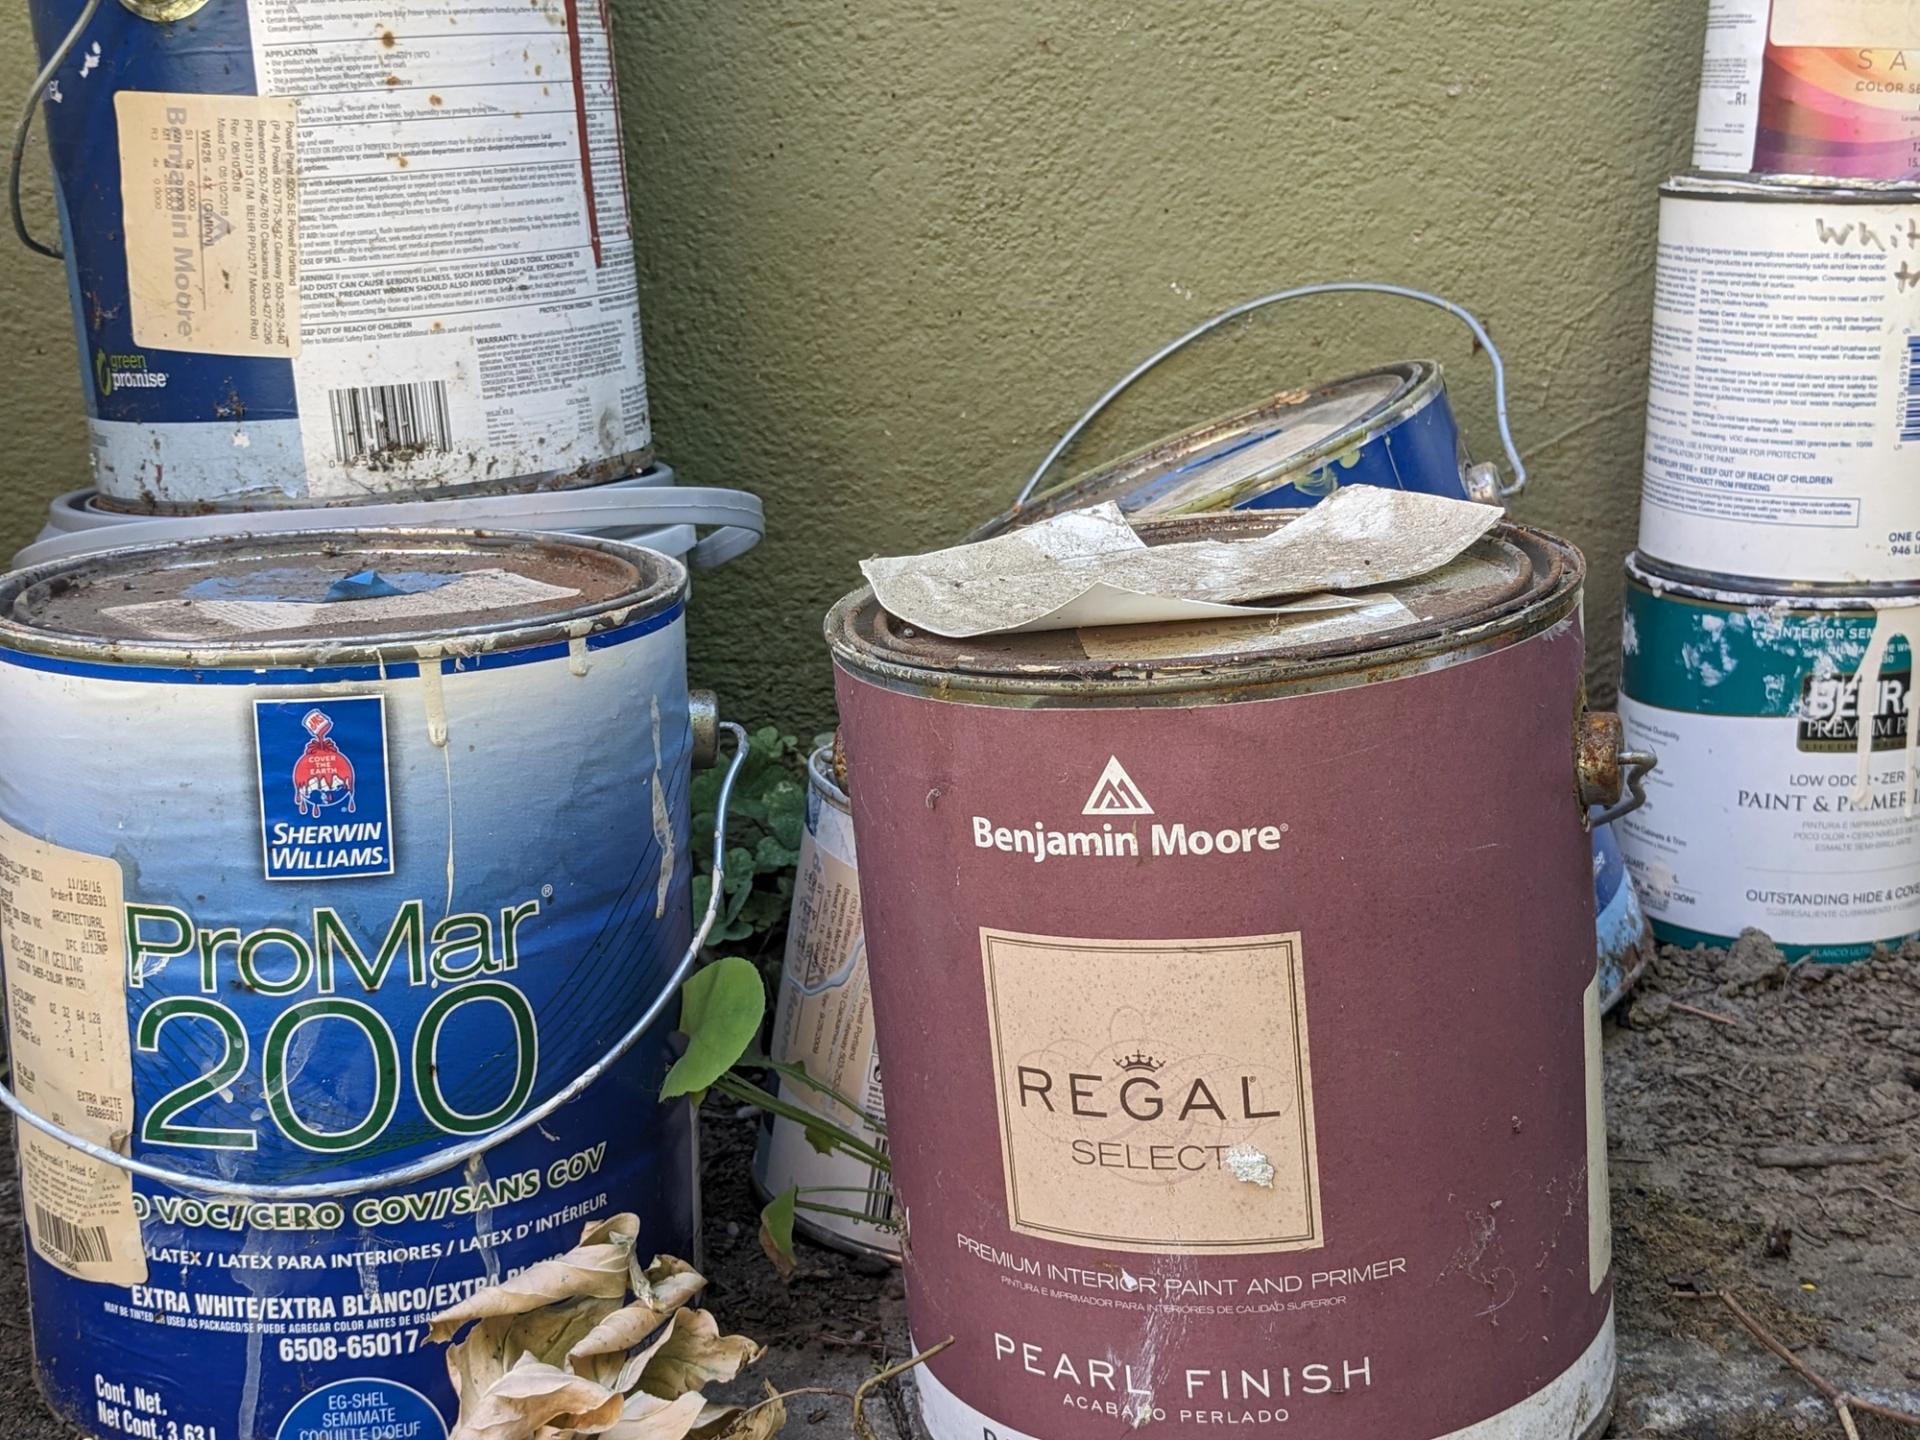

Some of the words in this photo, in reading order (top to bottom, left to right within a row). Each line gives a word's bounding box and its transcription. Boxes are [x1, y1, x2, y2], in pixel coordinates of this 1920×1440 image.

[265, 48, 318, 58] APPLICATION
[1856, 80, 1904, 93] COLOR
[258, 120, 267, 164] Beaverton
[270, 120, 281, 143] (P-4)
[286, 121, 296, 150] Powell
[272, 146, 282, 175] Powell
[286, 152, 296, 176] Paint
[246, 205, 256, 232] BEHR
[288, 203, 296, 216] SE
[288, 220, 297, 247] Powell
[260, 231, 270, 280] Clackamas
[273, 241, 284, 280] Gateway
[288, 250, 298, 286] Portland
[502, 256, 520, 266] LEAD
[173, 246, 195, 338] Moore
[316, 282, 338, 290] DUST
[339, 281, 356, 290] CAN
[358, 279, 384, 288] CAUSE
[454, 272, 474, 281] SUCH
[475, 270, 484, 279] AS
[486, 268, 506, 278] BRAIN
[338, 288, 382, 298] PREGNANT
[383, 286, 415, 296] WOMEN
[416, 283, 448, 293] SHOULD
[449, 281, 469, 290] ALSO
[470, 276, 492, 287] AVOID
[249, 278, 258, 316] Morocco
[276, 282, 286, 344] 503-252-2440
[368, 324, 377, 332] OF
[378, 322, 412, 331] CHILDREN
[110, 354, 146, 372] green
[112, 368, 167, 391] promise
[1718, 468, 1734, 478] OUT
[1747, 472, 1775, 482] REACH
[1777, 474, 1788, 483] OF
[1790, 474, 1833, 485] CHILDREN
[1888, 532, 1912, 542] ONE
[308, 755, 336, 763] COVER
[310, 766, 337, 775] EARTH
[1789, 774, 1824, 787] LOW
[1738, 789, 1807, 812] PAINT
[1812, 796, 1830, 813] &
[272, 822, 382, 846] SHERWIN
[972, 815, 1139, 863] Benjamin
[1151, 822, 1282, 856] Moore
[272, 846, 384, 870] WILLIAMS
[1745, 889, 1849, 906] OUTSTANDING
[1852, 890, 1884, 904] HIDE
[124, 898, 540, 994] ProMar
[136, 981, 540, 1152] 200
[1018, 1066, 1282, 1122] REGAL
[1072, 1138, 1231, 1171] SELECT
[152, 1195, 346, 1232] VOC/CERO
[353, 1168, 542, 1227] COV/SANS
[547, 1141, 608, 1188] COV
[151, 1246, 202, 1266] LATEX
[218, 1253, 273, 1270] LATEX
[278, 1253, 326, 1270] PARA
[331, 1243, 442, 1268] INTERIORES
[459, 1225, 513, 1252] LATEX
[956, 1232, 1041, 1277] PREMIUM
[1047, 1264, 1158, 1294] INTERIOR
[1166, 1278, 1238, 1296] PAINT
[1246, 1275, 1303, 1296] AND
[1311, 1257, 1407, 1290] PRIMER
[131, 1284, 190, 1314] EXTRA
[195, 1293, 337, 1321] WHITE/EXTRA
[1001, 1274, 1040, 1294] PINTURA
[1041, 1287, 1048, 1296] E
[1050, 1288, 1113, 1308] IMPRIMADOR
[1114, 1300, 1145, 1312] PARA
[1146, 1302, 1215, 1315] INTERIORES
[1217, 1304, 1234, 1315] DE
[1236, 1302, 1284, 1314] CALIDAD
[1286, 1295, 1347, 1312] SUPERIOR
[104, 1301, 119, 1314] MAY
[120, 1305, 129, 1317] BE
[130, 1307, 154, 1322] TINTED
[166, 1314, 186, 1328] USED
[187, 1317, 198, 1329] AS
[199, 1319, 255, 1334] PACKAGED/SE
[256, 1322, 286, 1334] PUEDE
[288, 1321, 331, 1335] AGREGAR
[334, 1319, 364, 1332] COLOR
[366, 1317, 396, 1330] ANTES
[399, 1314, 411, 1326] DE
[279, 1328, 419, 1362] 6508-65017
[994, 1332, 1152, 1396] PEARL
[1185, 1357, 1372, 1400] FINISH
[95, 1373, 132, 1408] Cont.
[134, 1386, 168, 1416] Net.
[328, 1392, 388, 1411] EG-SHEL
[97, 1401, 121, 1430] Net
[322, 1408, 396, 1428] SEMIMATE
[1180, 1408, 1290, 1424] PERLADO
[371, 1420, 422, 1440] D'OEUF
